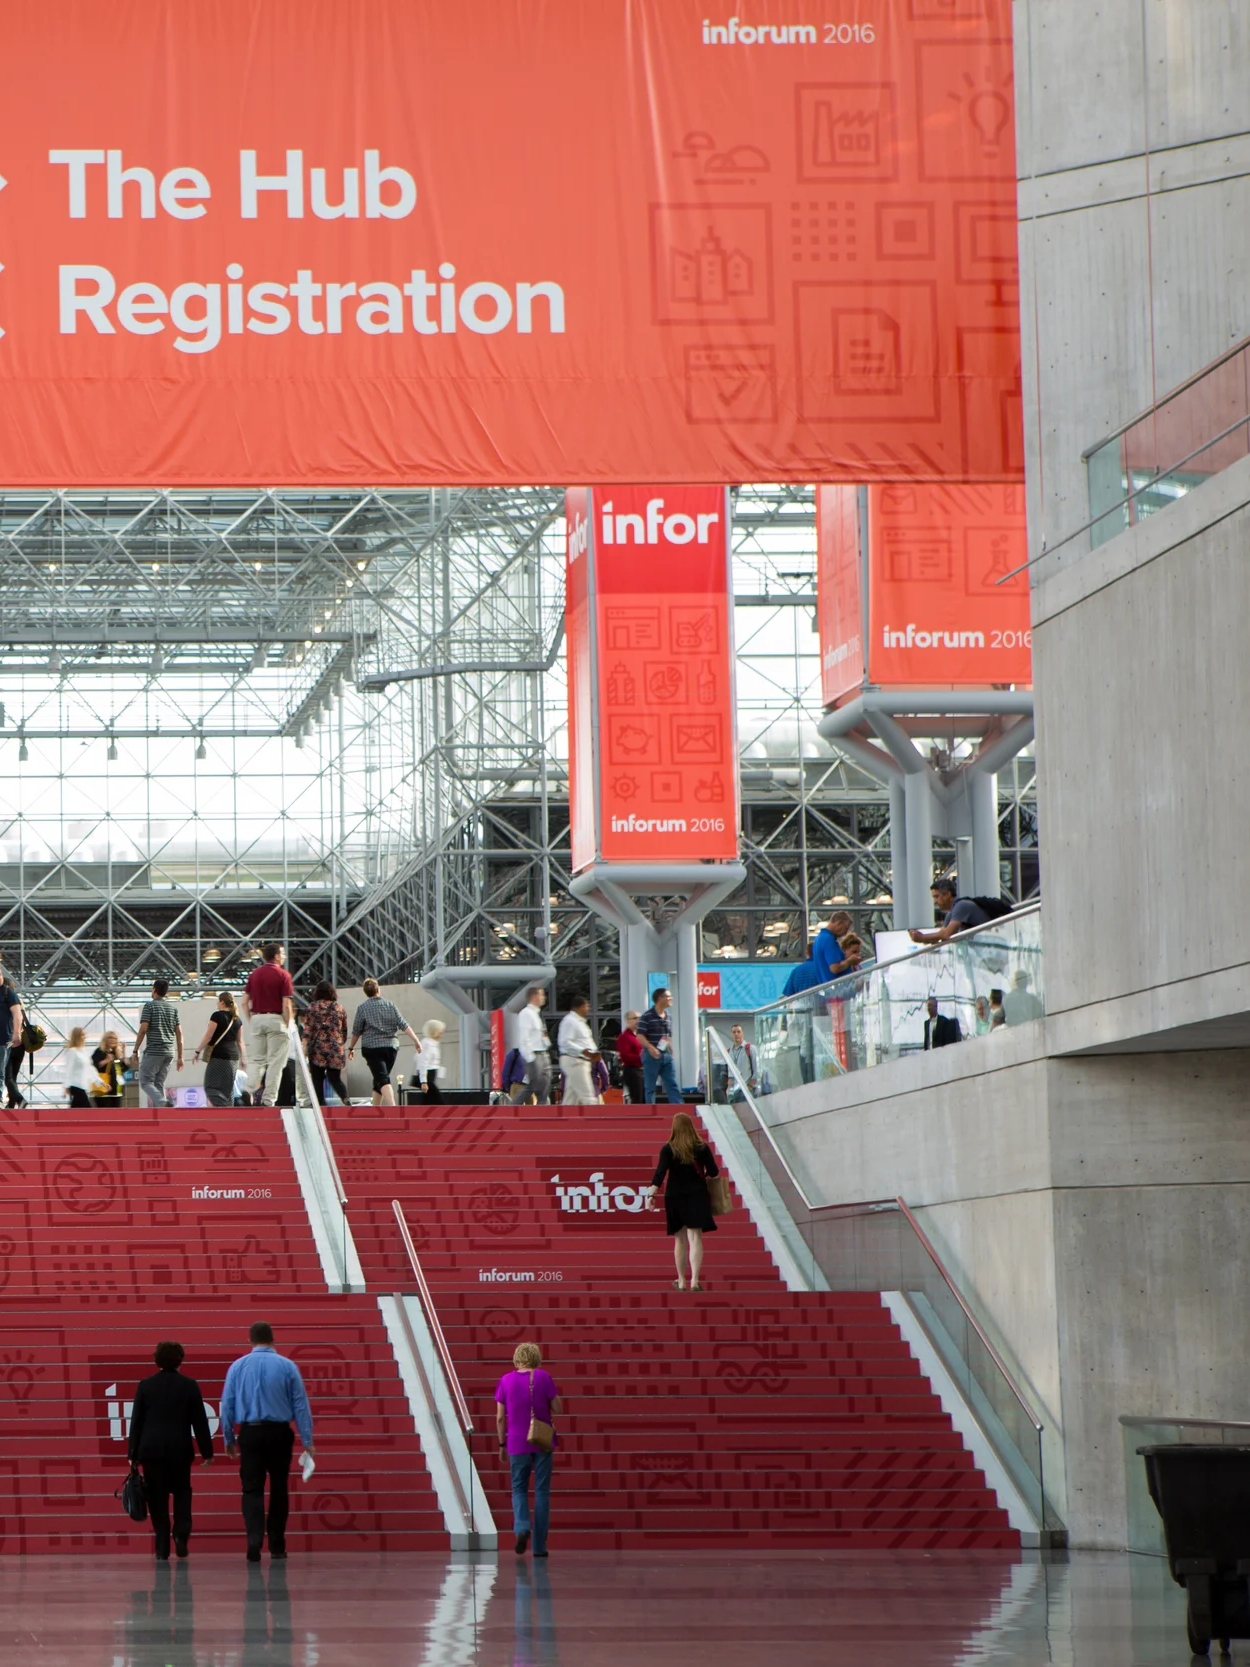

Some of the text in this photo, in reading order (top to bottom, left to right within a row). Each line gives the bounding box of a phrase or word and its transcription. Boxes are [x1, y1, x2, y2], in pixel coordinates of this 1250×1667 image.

[703, 16, 875, 44] inforum 2016
[49, 149, 417, 220] The Hub
[58, 262, 565, 354] Registration
[602, 498, 719, 544] infor
[883, 623, 1032, 648] inforum 2016
[611, 814, 725, 832] inforum 2016
[696, 982, 718, 996] for
[192, 1186, 272, 1199] inforum 2016
[551, 1172, 660, 1213] infor
[479, 1268, 563, 1282] inforum 2016
